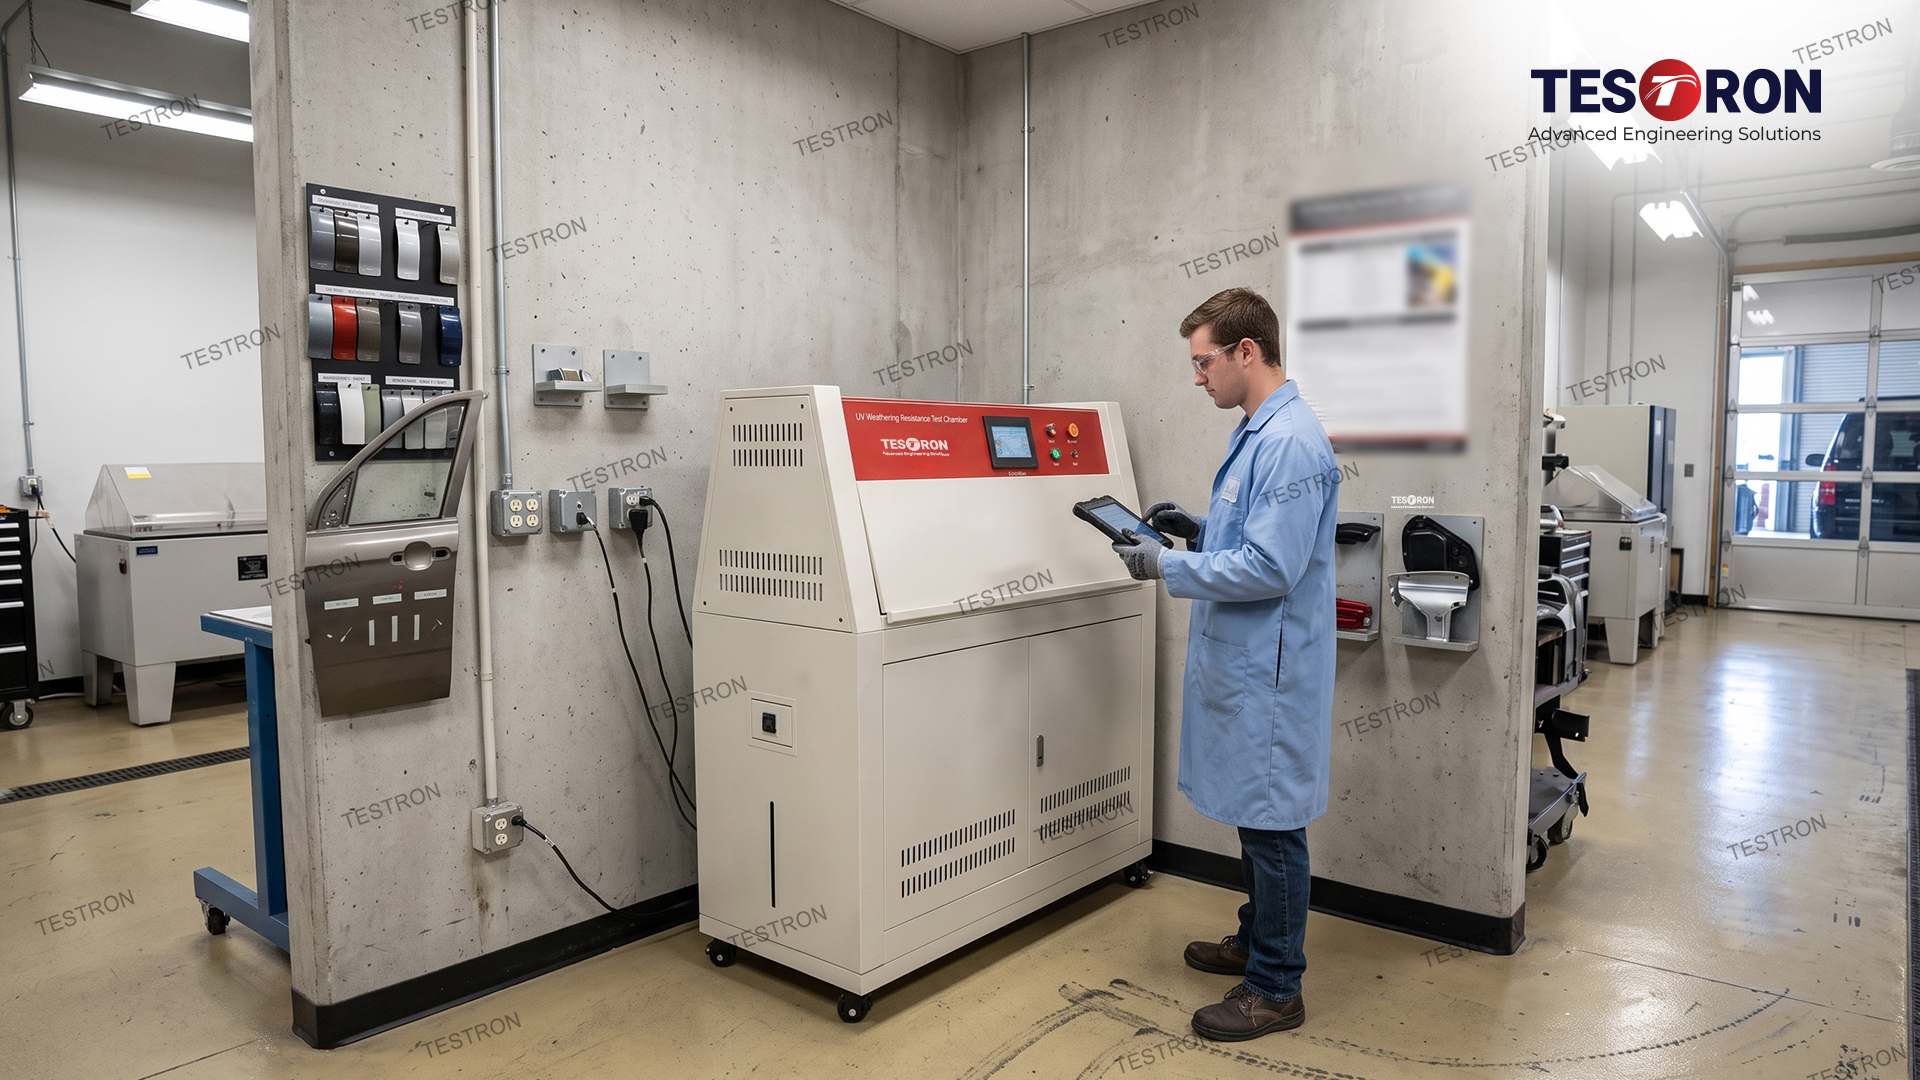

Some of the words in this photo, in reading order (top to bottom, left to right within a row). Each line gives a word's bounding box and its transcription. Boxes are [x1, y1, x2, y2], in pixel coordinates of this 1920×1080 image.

[855, 413, 865, 421] UV
[866, 413, 900, 424] Weathering
[900, 414, 931, 422] Resistance
[931, 415, 943, 423] Test
[943, 415, 968, 424] Chamber
[880, 437, 949, 451] TESTRON
[1391, 494, 1435, 505] TESTRON
